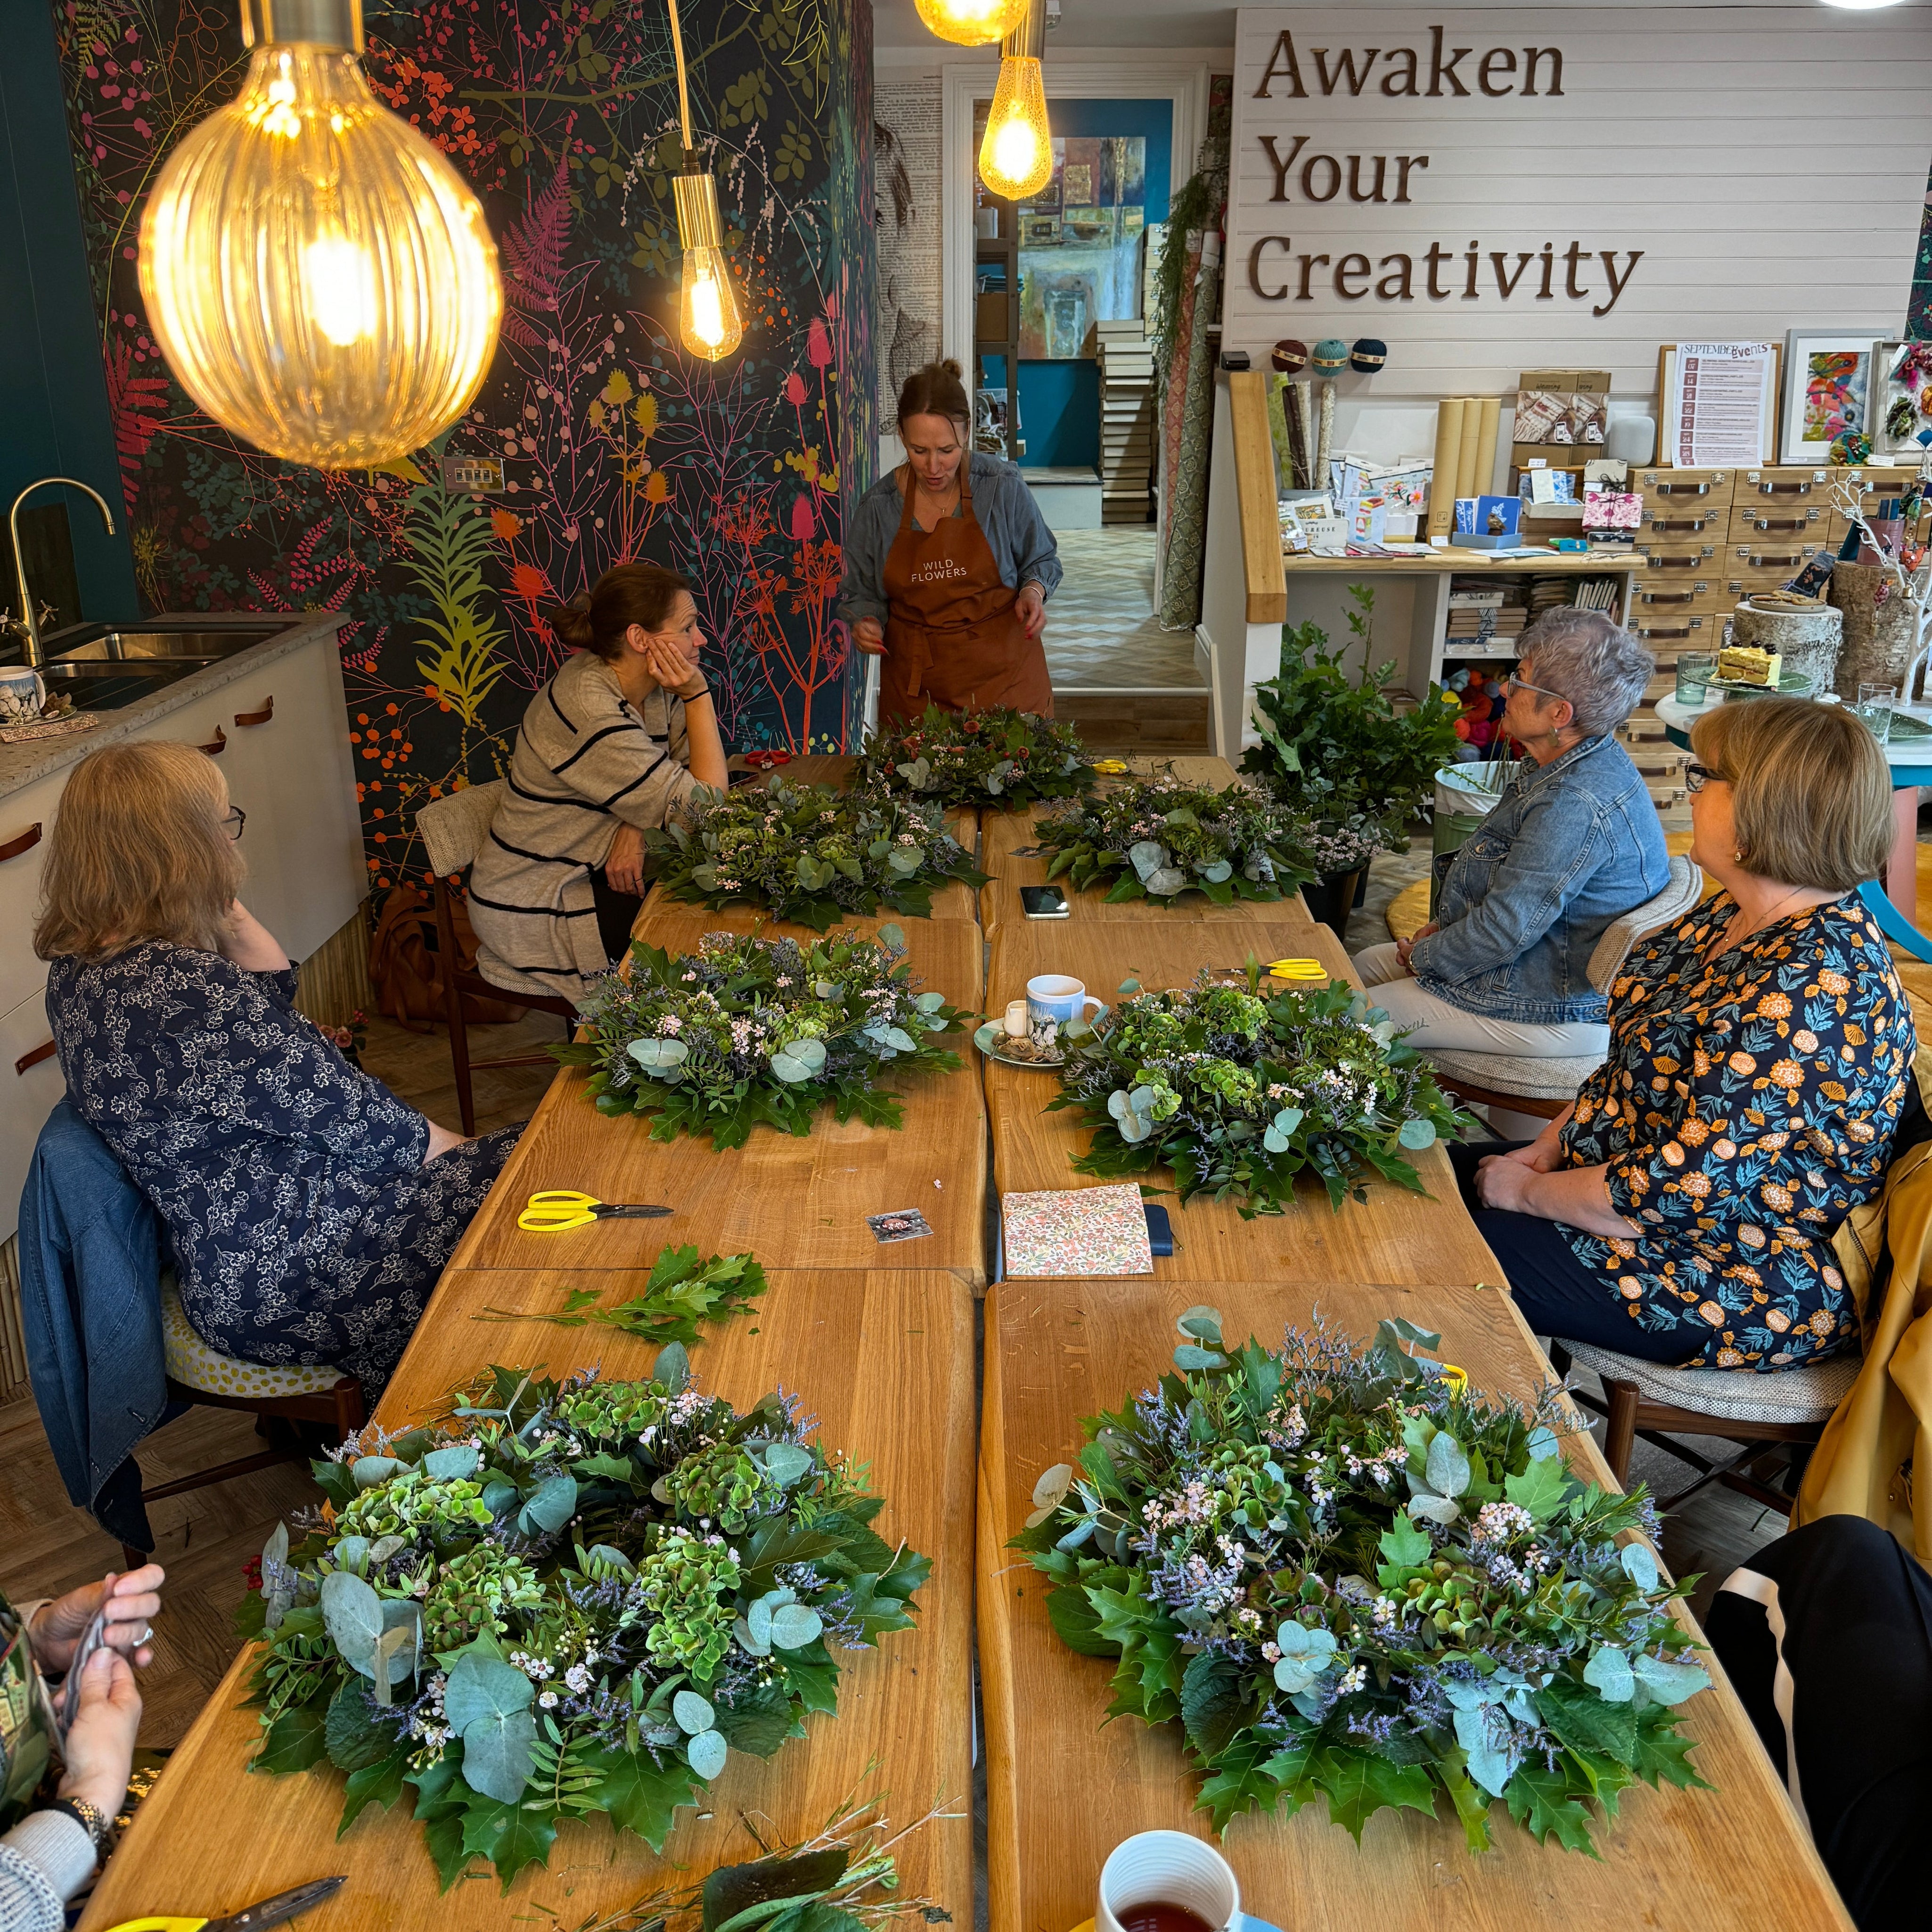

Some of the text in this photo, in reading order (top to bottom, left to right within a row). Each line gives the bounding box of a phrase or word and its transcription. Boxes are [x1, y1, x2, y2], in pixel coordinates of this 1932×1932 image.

[1252, 25, 1564, 99] Awaken
[1257, 136, 1429, 203] Your
[1247, 236, 1645, 317] Creativity
[1684, 344, 1738, 355] SEPTEMBER
[911, 567, 967, 582] FLOWERS
[923, 559, 953, 571] WILD
